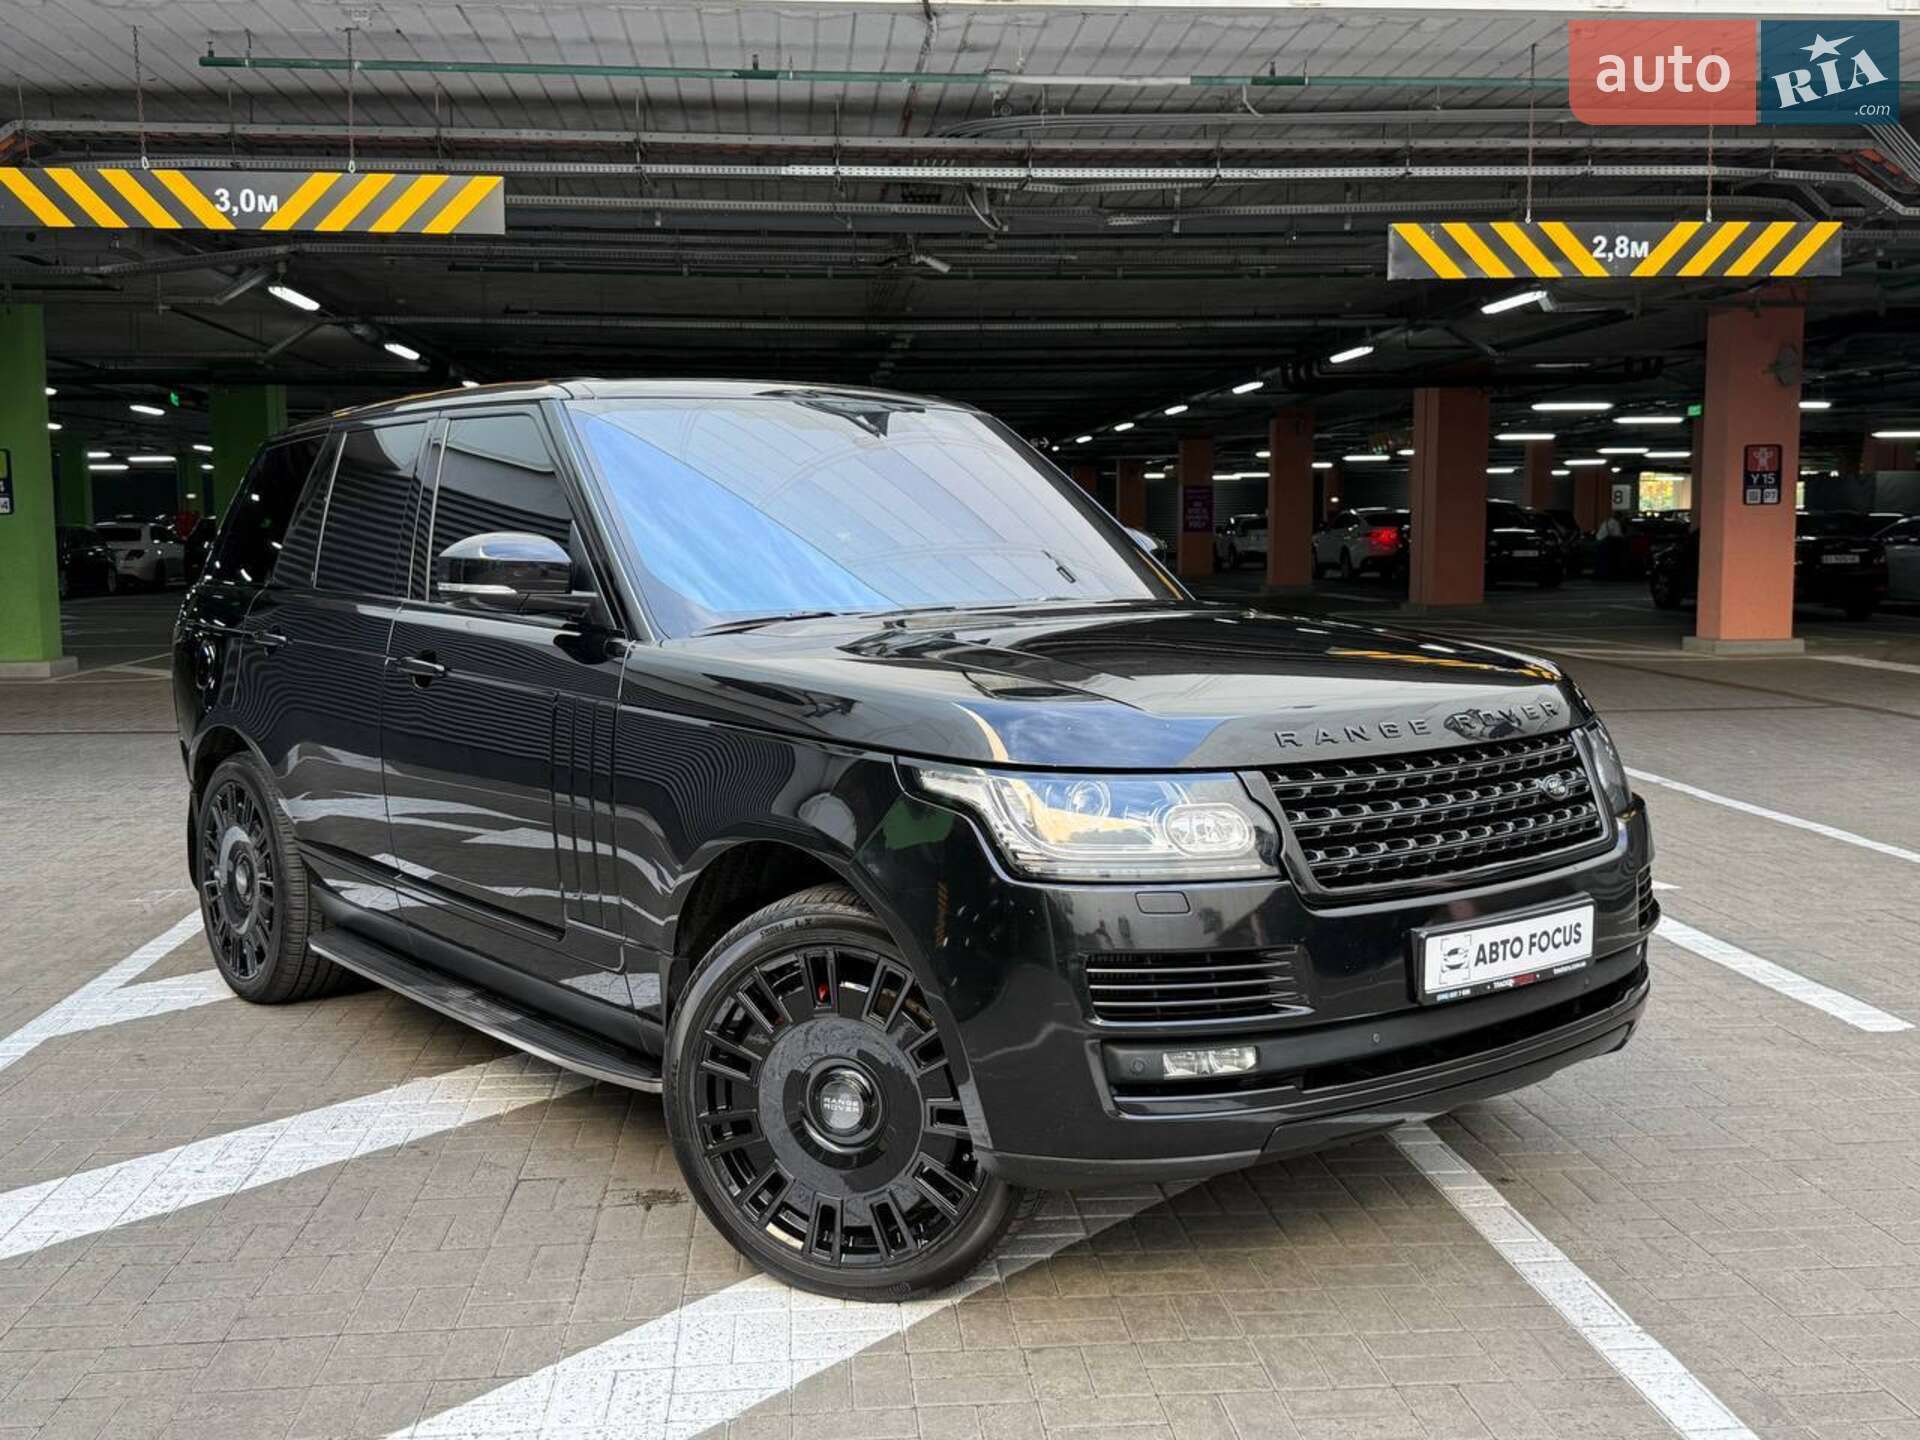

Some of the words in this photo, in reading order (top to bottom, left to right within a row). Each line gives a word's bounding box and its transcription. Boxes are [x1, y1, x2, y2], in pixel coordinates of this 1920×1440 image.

[214, 187, 279, 217] 3,0м
[1592, 235, 1650, 263] 2,8м
[1274, 719, 1432, 748] RANGE
[1453, 701, 1559, 730] ROVER
[1528, 922, 1583, 956] FOCUS
[823, 1097, 860, 1106] RANGE
[823, 1103, 860, 1113] ROVER
